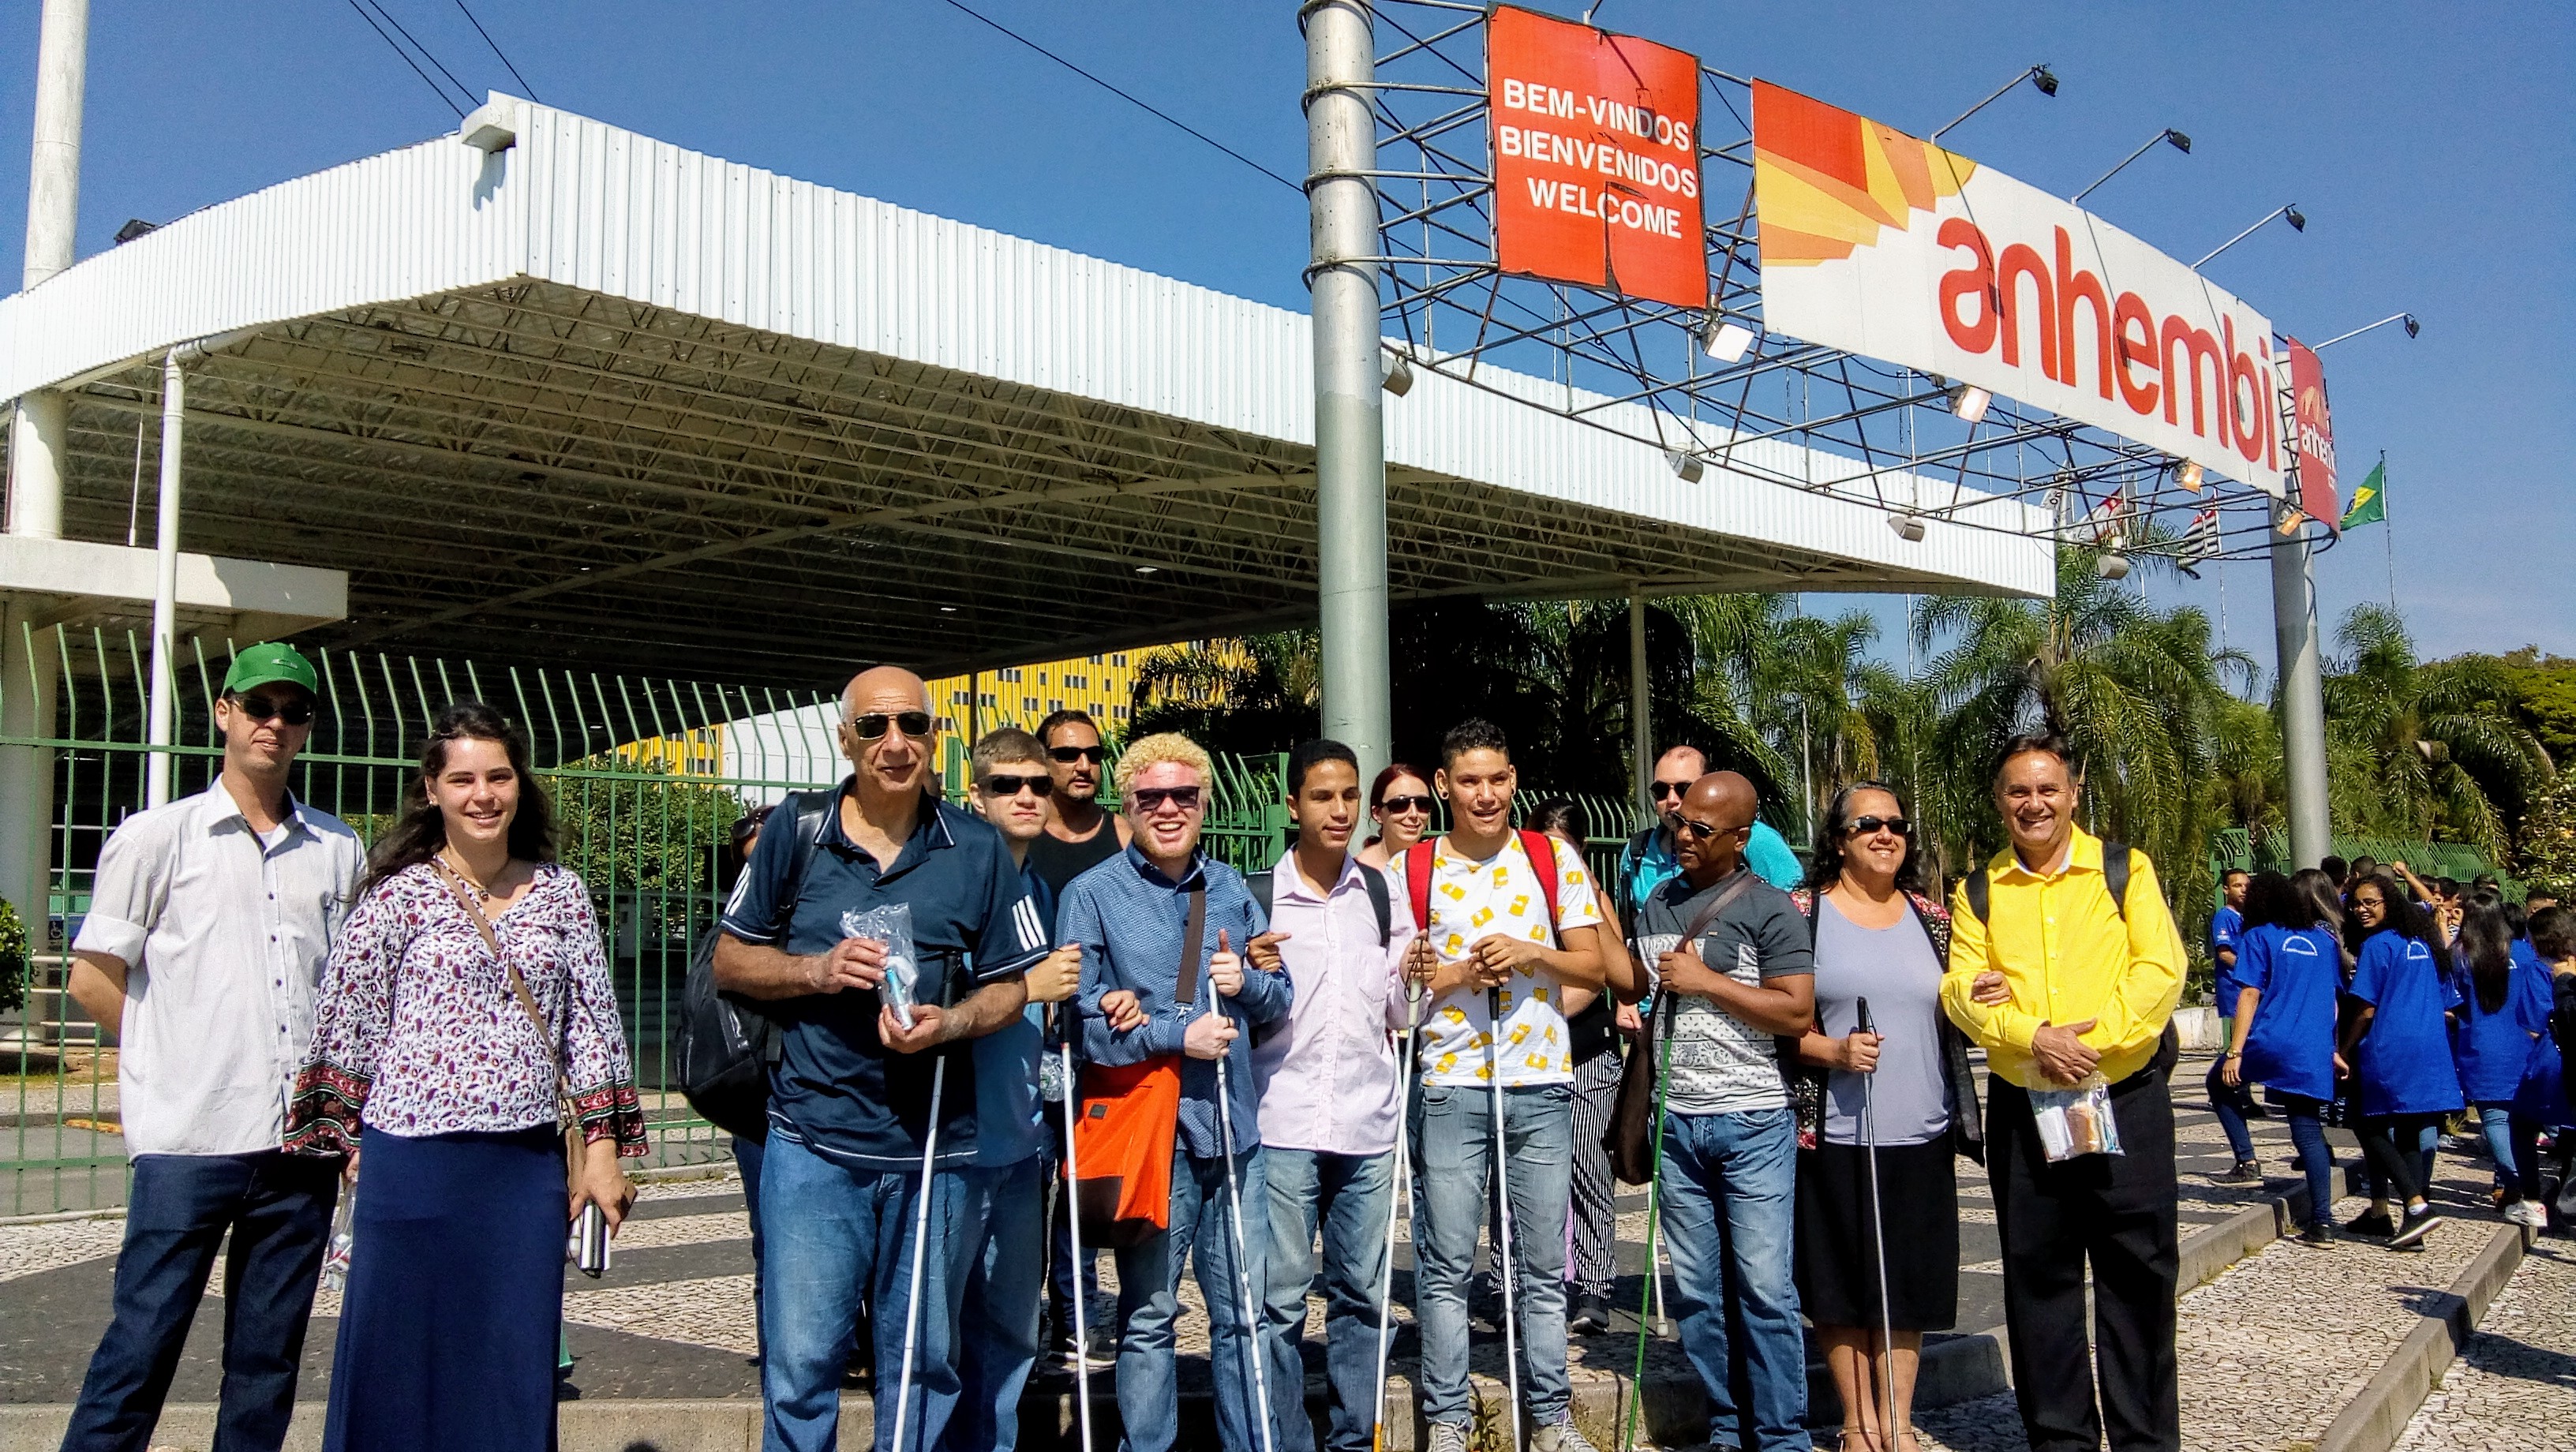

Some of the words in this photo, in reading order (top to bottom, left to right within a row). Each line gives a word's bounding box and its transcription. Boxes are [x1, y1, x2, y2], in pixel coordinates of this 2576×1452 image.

[1503, 77, 1691, 152] BEM-VINDOS
[1499, 125, 1698, 199] BIENVENIDOS
[1526, 177, 1683, 239] WELCOME
[1936, 216, 2278, 473] anhembi
